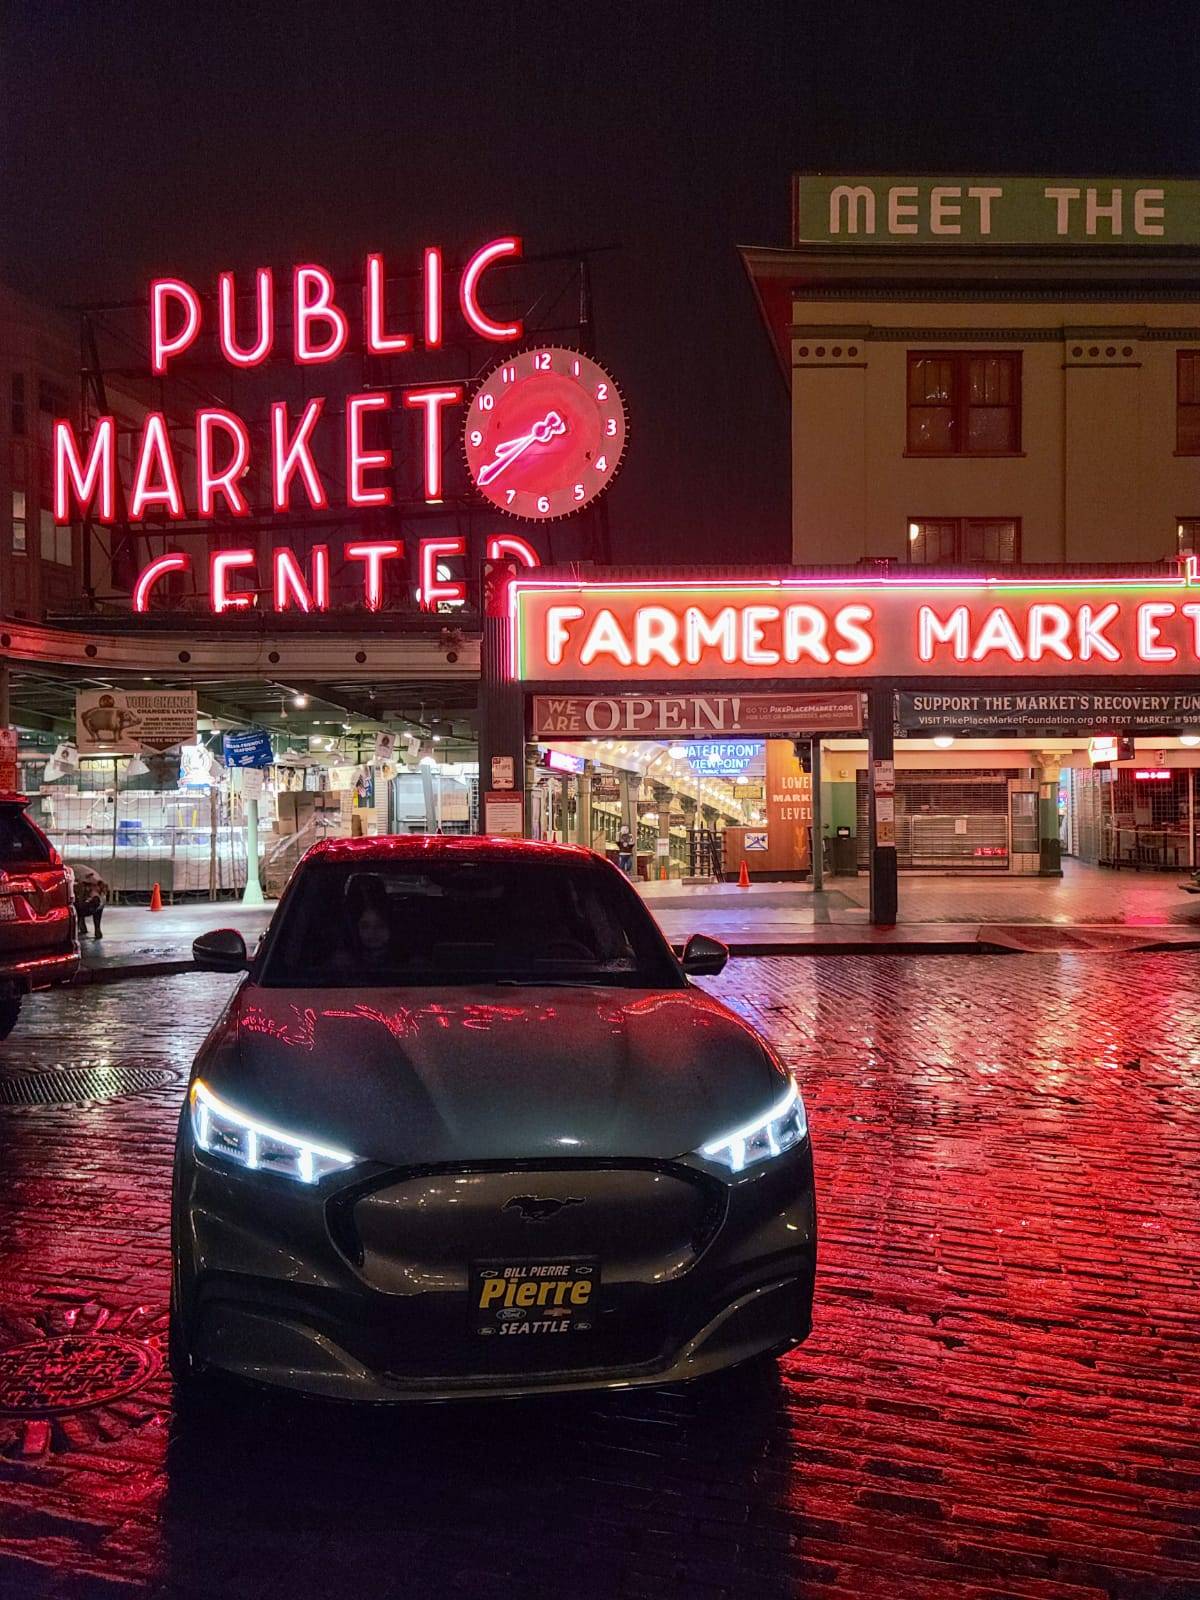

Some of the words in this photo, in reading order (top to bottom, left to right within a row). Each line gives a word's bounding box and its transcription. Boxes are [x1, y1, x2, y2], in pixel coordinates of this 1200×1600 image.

[829, 185, 1002, 234] MEET
[1045, 187, 1165, 235] THE
[151, 236, 523, 376] PUBLIC
[535, 352, 551, 370] 12
[573, 360, 580, 377] 1
[502, 366, 515, 383] 11
[597, 383, 608, 400] 2
[478, 394, 494, 410] 10
[606, 418, 617, 436] 3
[470, 430, 483, 447] 9
[53, 385, 469, 525] MARKET
[595, 455, 607, 472] 4
[505, 489, 516, 504] 7
[574, 484, 585, 500] 5
[537, 496, 550, 512] 6
[545, 605, 875, 667] FARMERS
[126, 695, 153, 708] YOUR
[154, 695, 193, 708] CHANGE
[548, 700, 579, 715] WE
[913, 696, 980, 711] SUPPORT
[984, 697, 1012, 711] THE
[1016, 696, 1089, 711] MARKET'S
[1093, 696, 1170, 710] RECOVERY
[1174, 696, 1200, 710] FUN
[585, 698, 741, 731] OPEN!
[745, 706, 757, 714] GO
[542, 716, 582, 731] ARE
[919, 716, 941, 725] VISIT
[943, 715, 1094, 726] PikePlaceMarketFoundation.org
[1095, 716, 1108, 724] OR
[1111, 716, 1131, 724] TEXT
[1182, 715, 1200, 724] 919
[688, 758, 750, 769] VIEWPOINT
[781, 776, 813, 789] LOWE
[773, 793, 813, 803] MARK
[781, 807, 813, 820] LEVEL
[504, 1266, 528, 1278] BILL
[529, 1265, 571, 1277] PIERRE
[479, 1278, 592, 1308] Pierre
[499, 1320, 570, 1335] SEATTLE
